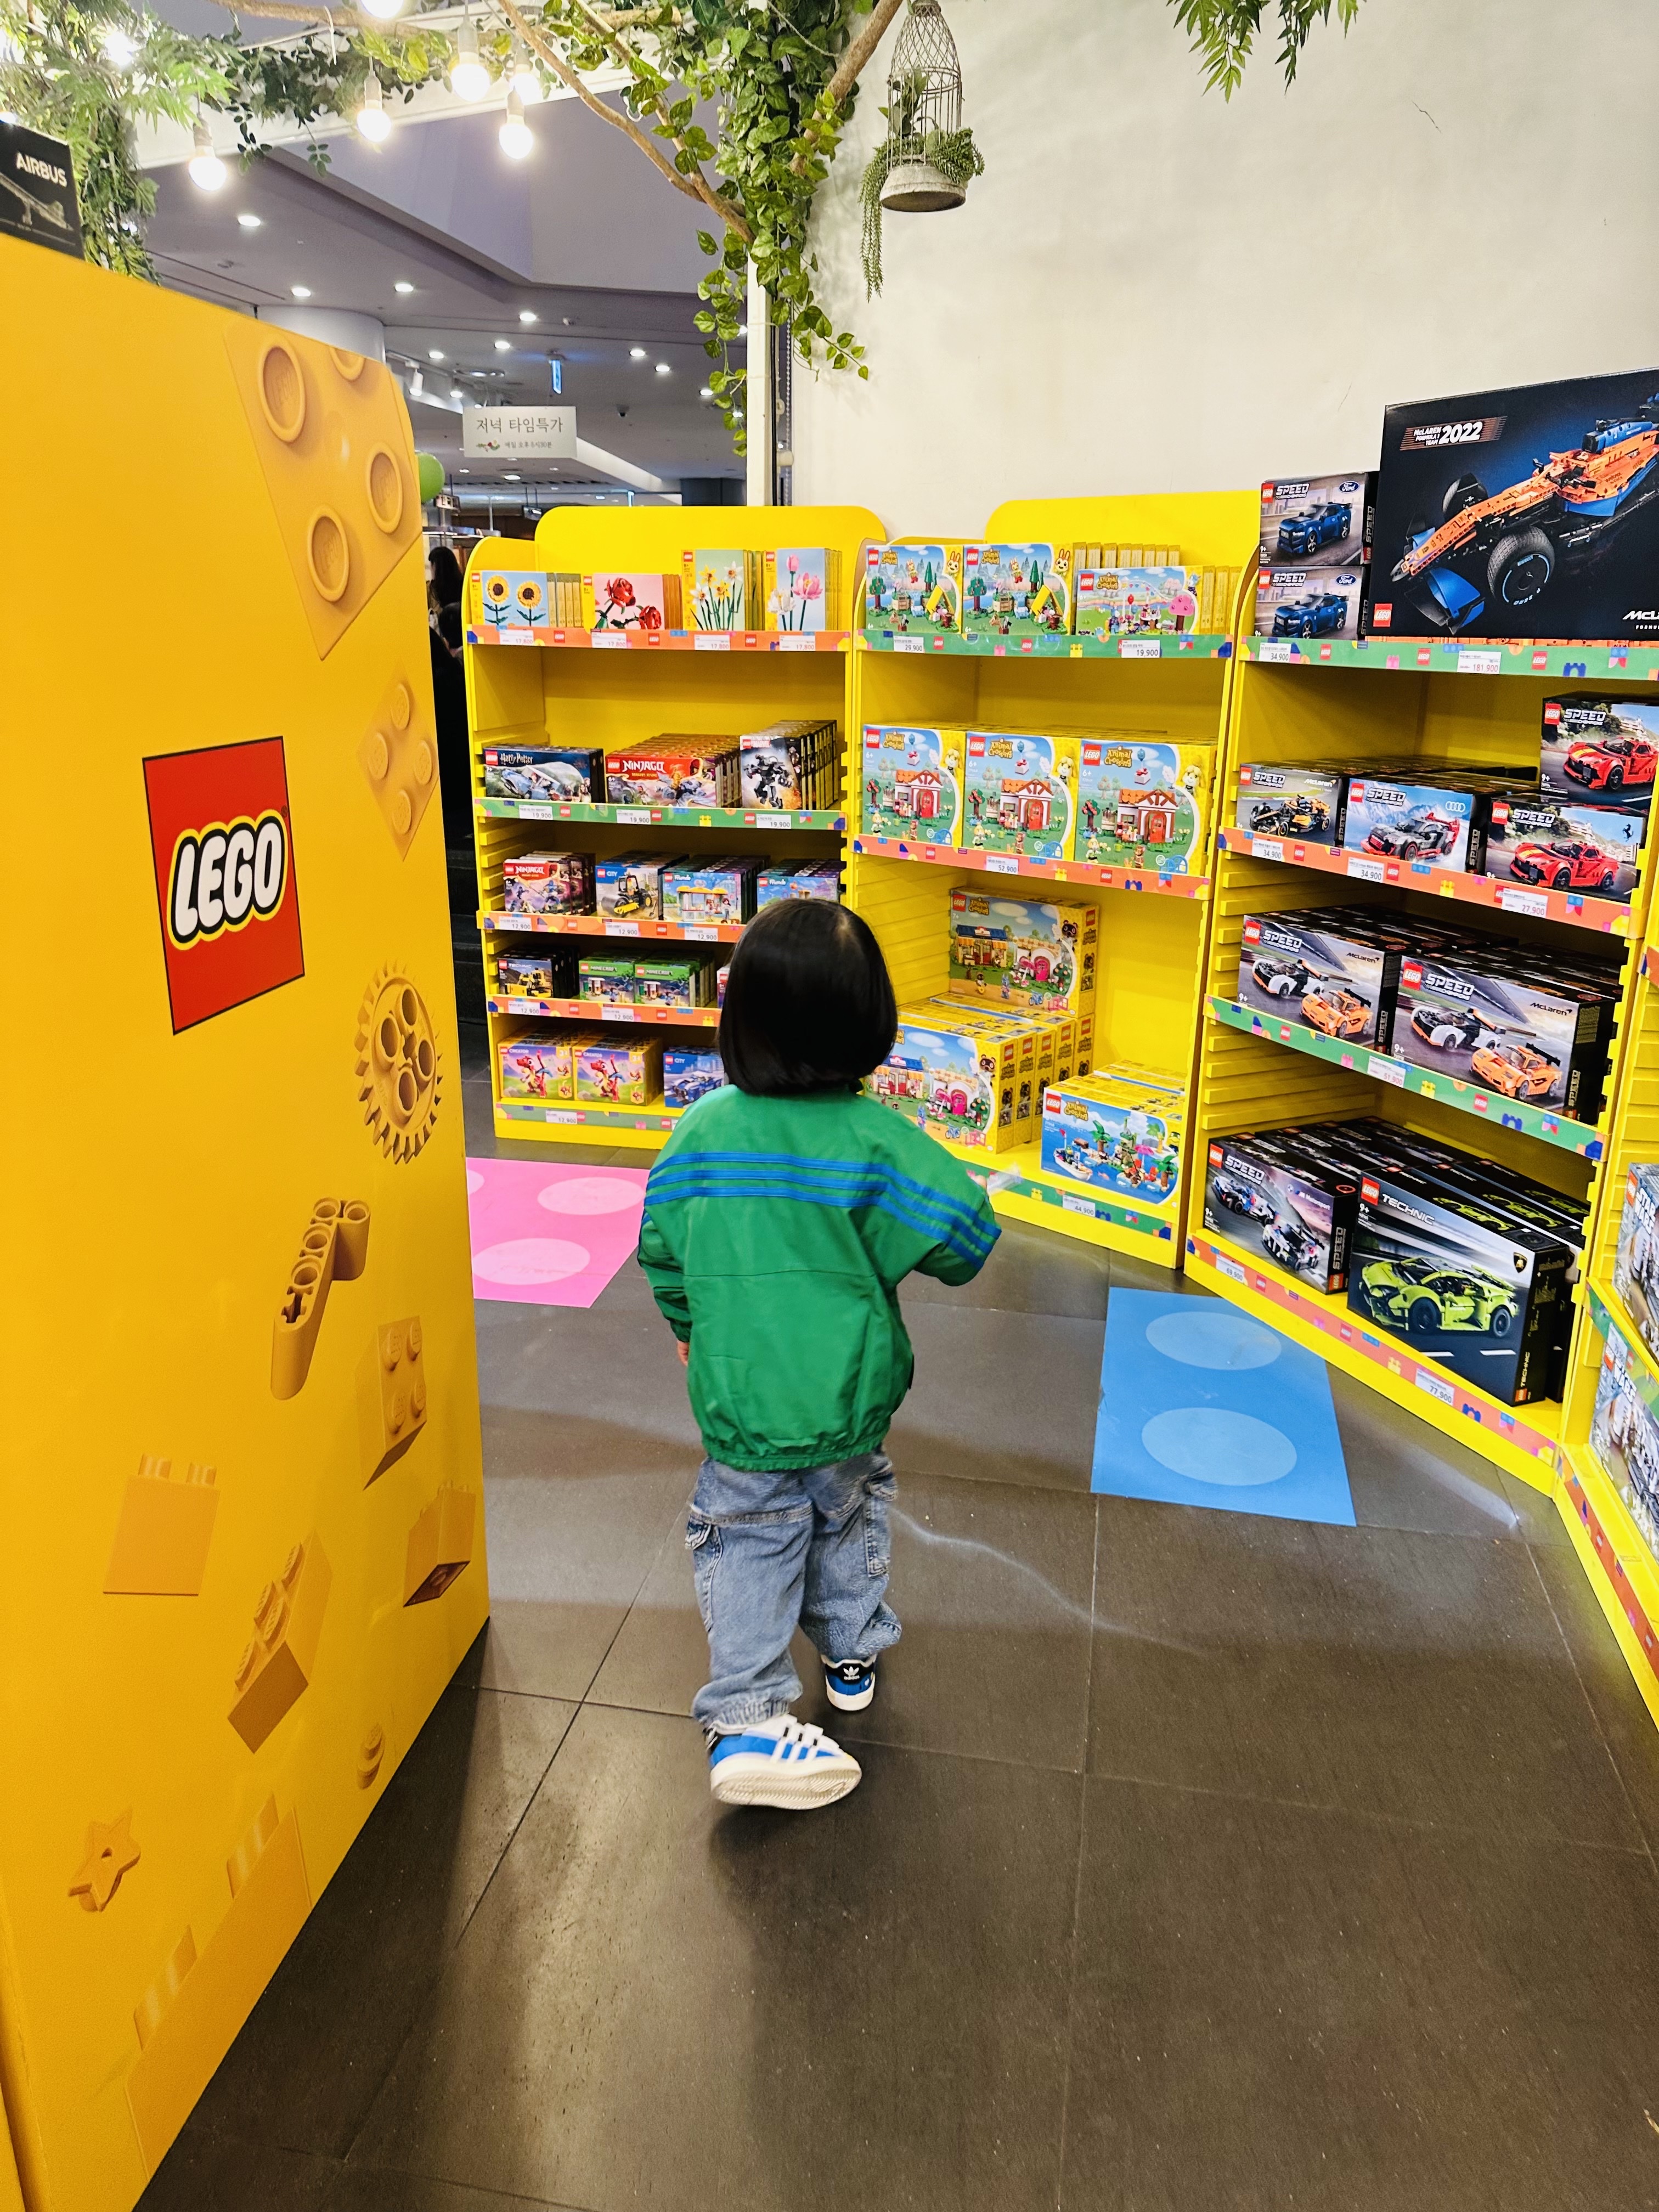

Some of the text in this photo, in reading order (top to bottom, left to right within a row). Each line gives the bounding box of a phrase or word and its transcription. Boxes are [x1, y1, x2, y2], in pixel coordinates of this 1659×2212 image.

[16, 152, 67, 188] AIRBUS
[477, 417, 563, 433] 저녁 타임특가
[1439, 421, 1483, 444] 2022
[1276, 483, 1309, 495] SPEED
[1342, 483, 1356, 492] Ford
[1273, 573, 1306, 582] SPEED
[1374, 610, 1391, 621] LEGO
[1623, 611, 1659, 620] McL
[1271, 653, 1288, 661] 34,900
[1474, 664, 1498, 672] 181,900
[1545, 709, 1560, 718] LEGO
[1564, 709, 1606, 721] SPEED
[883, 741, 904, 749] Crossing
[500, 753, 533, 765] Harry Potter
[989, 749, 1012, 758] Crossing
[1084, 751, 1099, 759] LEGO
[1107, 749, 1131, 758] Animal
[622, 760, 667, 773] NINJAGO
[1105, 757, 1131, 766] Crossing
[1254, 771, 1285, 783] SPEED
[1304, 779, 1332, 787] McLaren
[1351, 788, 1363, 797] LEGO
[1367, 788, 1406, 802] SPEED
[1493, 809, 1508, 817] LEGO
[1512, 809, 1555, 823] SPEED
[1469, 829, 1479, 866] SPEED
[1263, 850, 1281, 859] 34,900
[515, 866, 545, 874] NINJAGO
[998, 865, 1017, 873] 52,900
[171, 815, 285, 944] LEGO
[1361, 870, 1381, 881] 34,900
[1245, 927, 1260, 938] LEGO
[1263, 930, 1302, 948] SPEED
[1403, 969, 1421, 982] LEGO
[1426, 973, 1475, 995] SPEED
[1239, 993, 1248, 1001] 9+
[1530, 1002, 1567, 1016] McLaren
[1395, 1043, 1404, 1053] 9+
[1046, 1098, 1061, 1109] LEGO
[1066, 1102, 1086, 1114] Animal
[1065, 1109, 1088, 1120] Crossing
[1210, 1150, 1222, 1161] LEGO
[1225, 1155, 1265, 1180] SPEED
[1362, 1184, 1379, 1198] LEGO
[1360, 1203, 1369, 1213] 9+
[1383, 1194, 1435, 1225] TECHNIC
[1636, 1187, 1656, 1223] STAR
[1205, 1207, 1212, 1216] 9+
[1635, 1197, 1655, 1235] WARS
[1333, 1227, 1343, 1269] SPEED
[1521, 1351, 1531, 1387] TECHNIC
